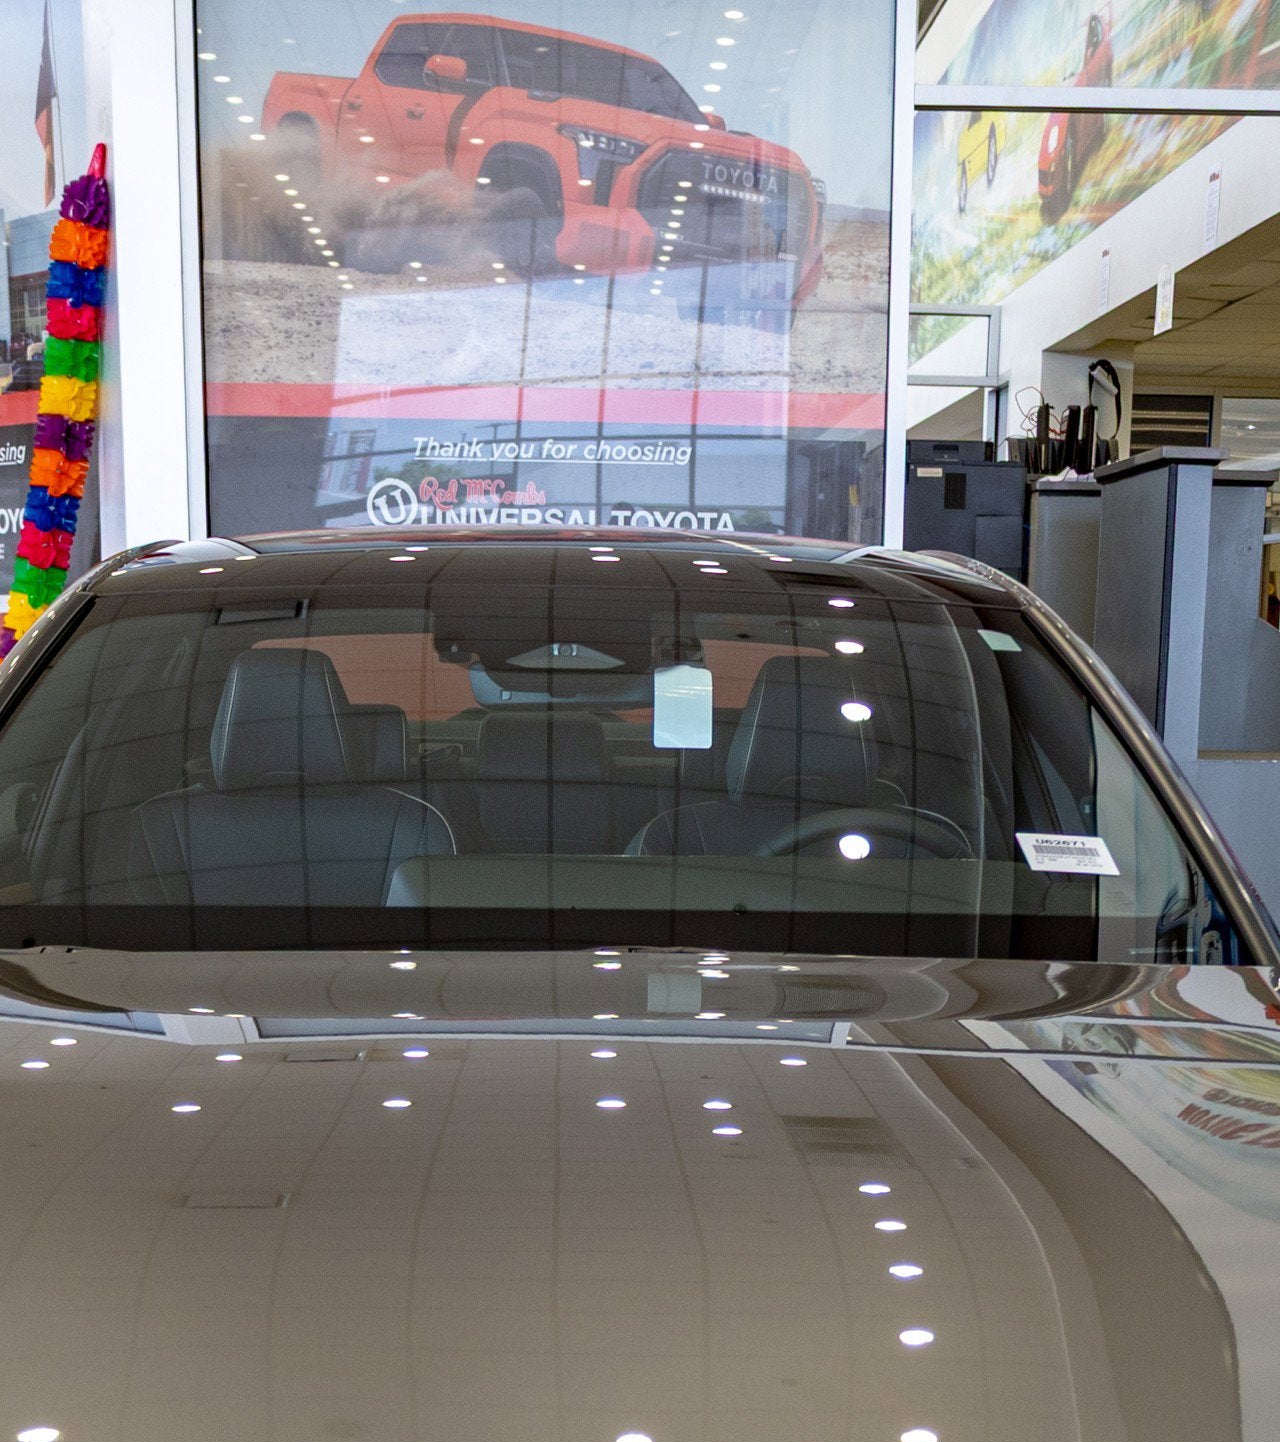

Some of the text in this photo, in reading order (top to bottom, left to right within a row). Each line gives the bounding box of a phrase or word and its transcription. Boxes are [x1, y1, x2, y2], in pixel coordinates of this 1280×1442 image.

[701, 161, 778, 194] TOYOTA
[413, 437, 693, 466] Thank you for choosing
[420, 476, 459, 511] Red
[610, 510, 736, 532] TOYOTA
